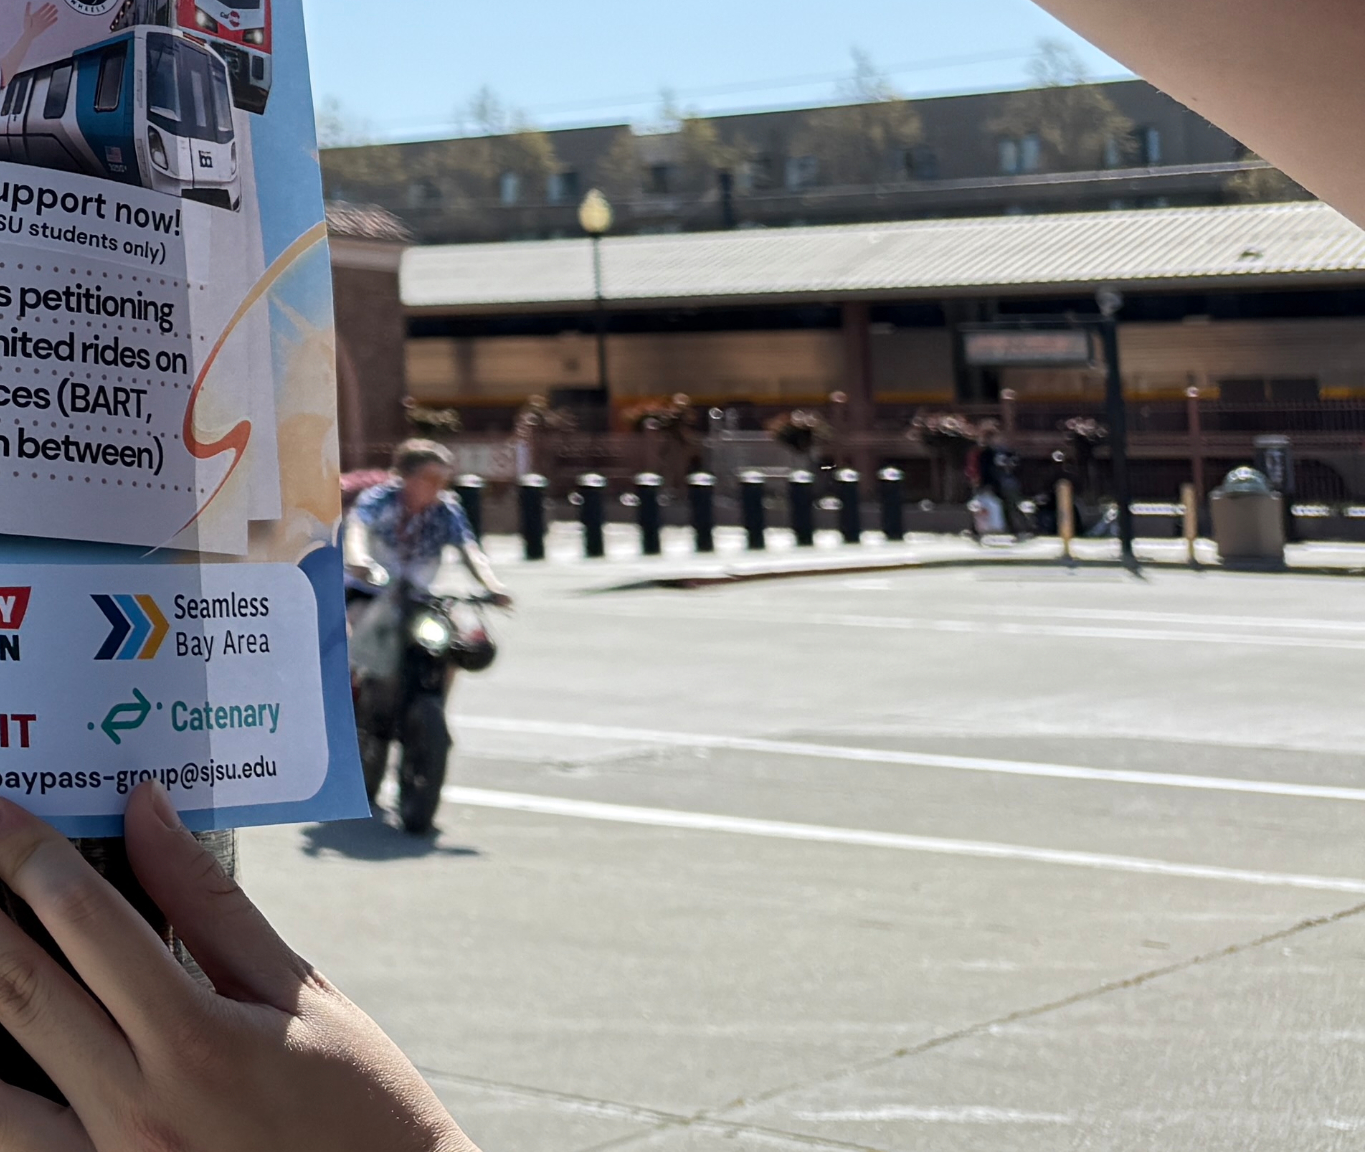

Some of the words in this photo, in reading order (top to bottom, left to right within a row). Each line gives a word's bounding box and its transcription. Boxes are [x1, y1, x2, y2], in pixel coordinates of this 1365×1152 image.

[115, 201, 181, 236] now!
[28, 222, 118, 251] students
[122, 240, 167, 266] only)
[19, 282, 175, 334] petitioning
[81, 334, 151, 368] rides
[155, 350, 188, 375] on
[57, 377, 152, 425] (BART,
[17, 427, 164, 476] between)
[173, 591, 270, 620] Seamless
[175, 631, 215, 663] Bay
[223, 629, 271, 655] Area
[171, 700, 281, 734] Catenary
